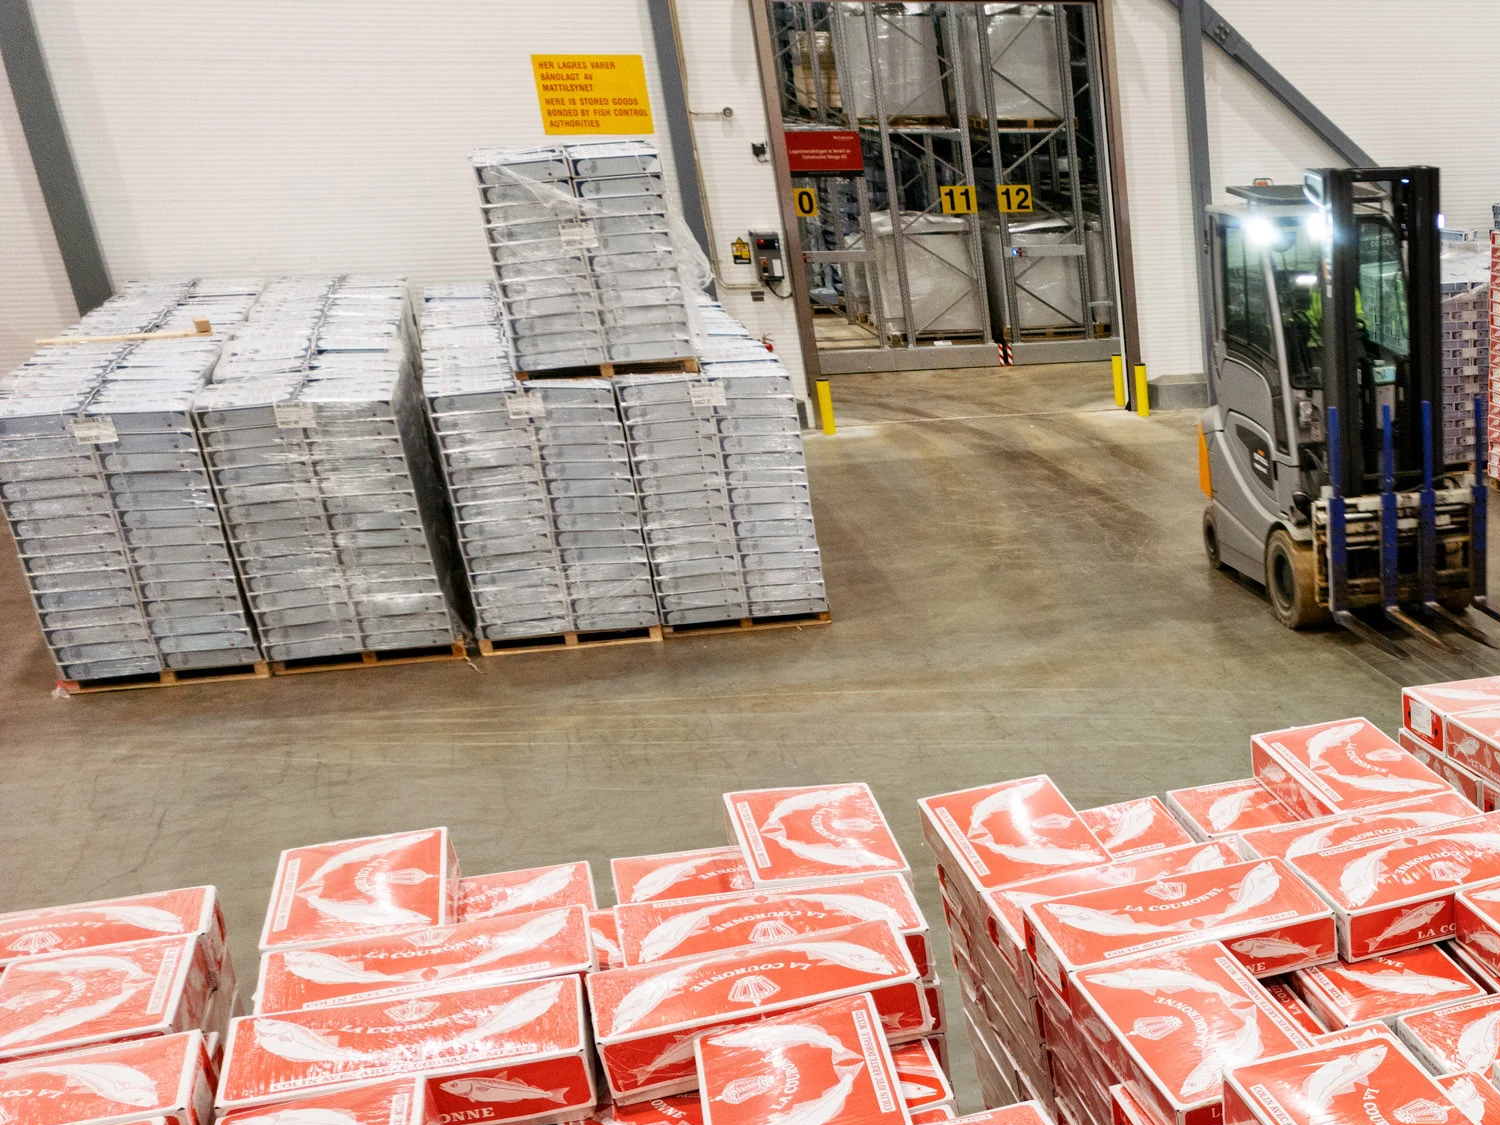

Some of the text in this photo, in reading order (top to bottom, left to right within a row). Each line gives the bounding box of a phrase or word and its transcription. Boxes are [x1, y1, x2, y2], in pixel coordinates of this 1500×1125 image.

[540, 72, 579, 80] BÅNDLAGT
[542, 84, 594, 92] MATTILSYNET
[545, 98, 638, 106] HERE IS STORED GOODS
[550, 120, 600, 128] AUTHORITIES
[944, 188, 971, 211] 11
[1001, 188, 1030, 210] 12
[691, 964, 787, 992] COURONNE
[1363, 1087, 1379, 1100] LA
